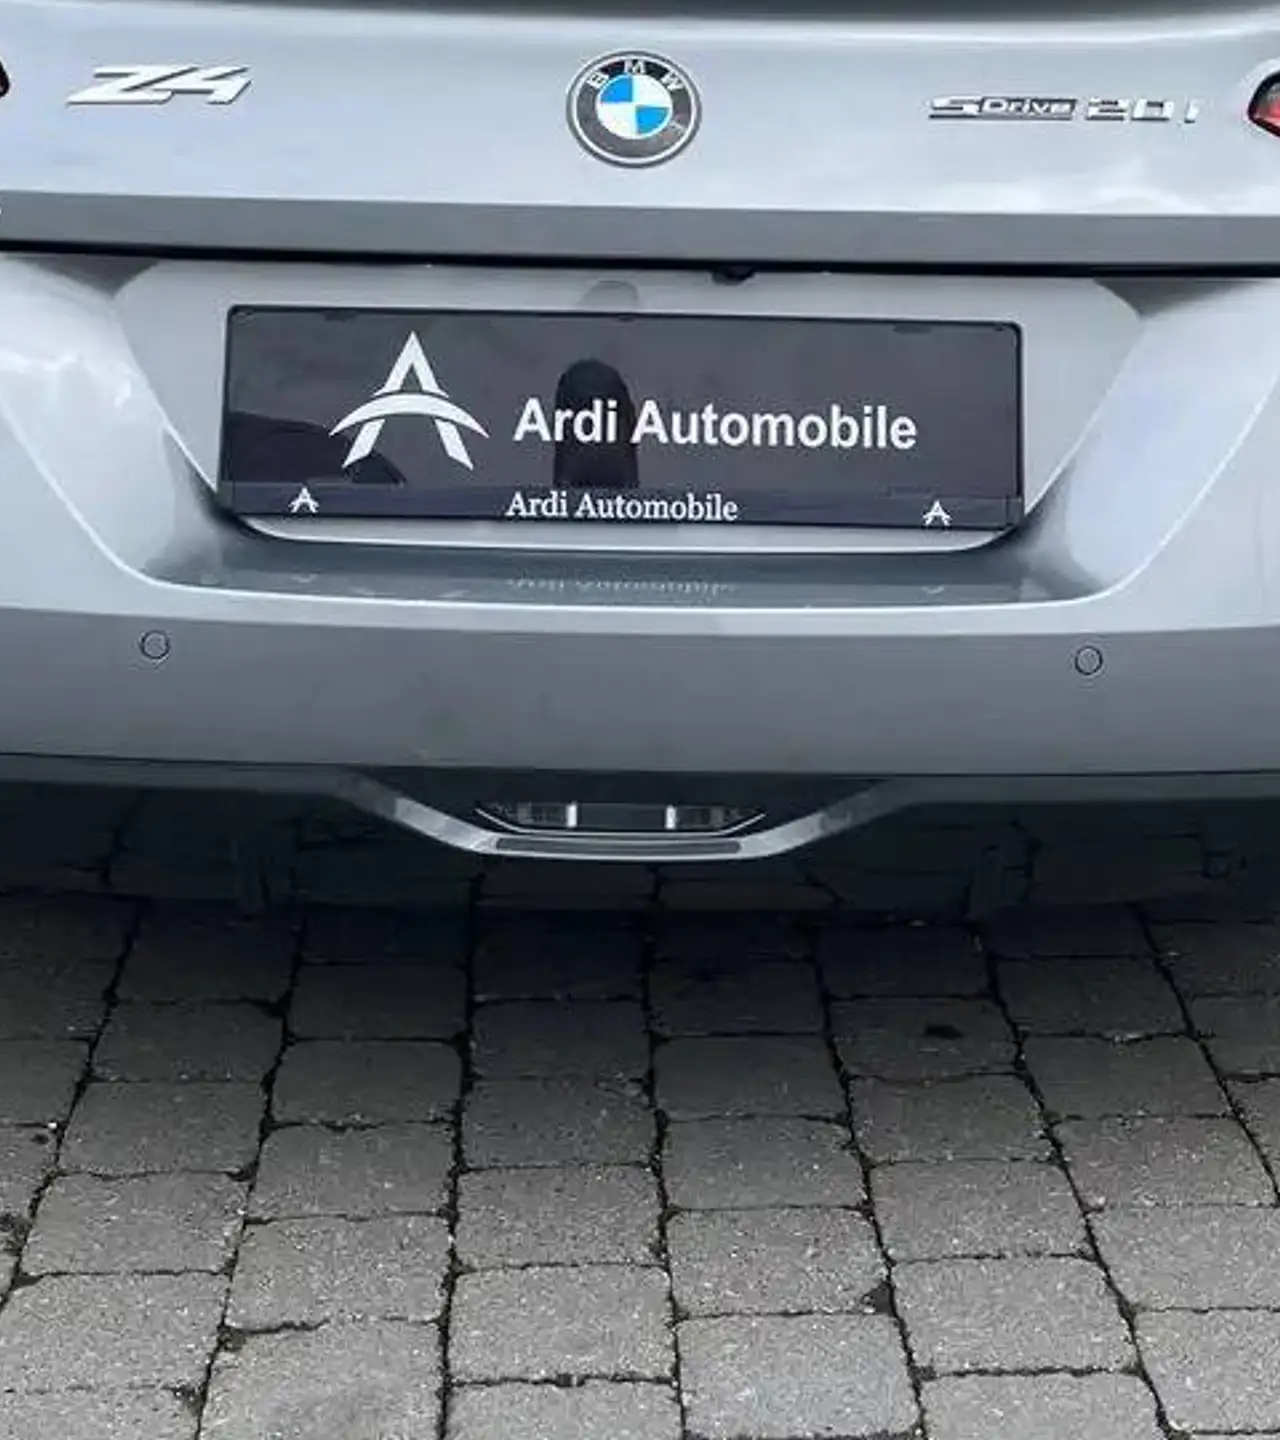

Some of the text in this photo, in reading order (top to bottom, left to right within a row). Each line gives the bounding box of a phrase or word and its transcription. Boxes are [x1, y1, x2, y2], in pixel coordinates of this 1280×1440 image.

[66, 64, 253, 107] Z4
[586, 59, 684, 91] BMW
[513, 397, 918, 450] Ardi Automobile
[504, 490, 739, 522] Ardi Automobile
